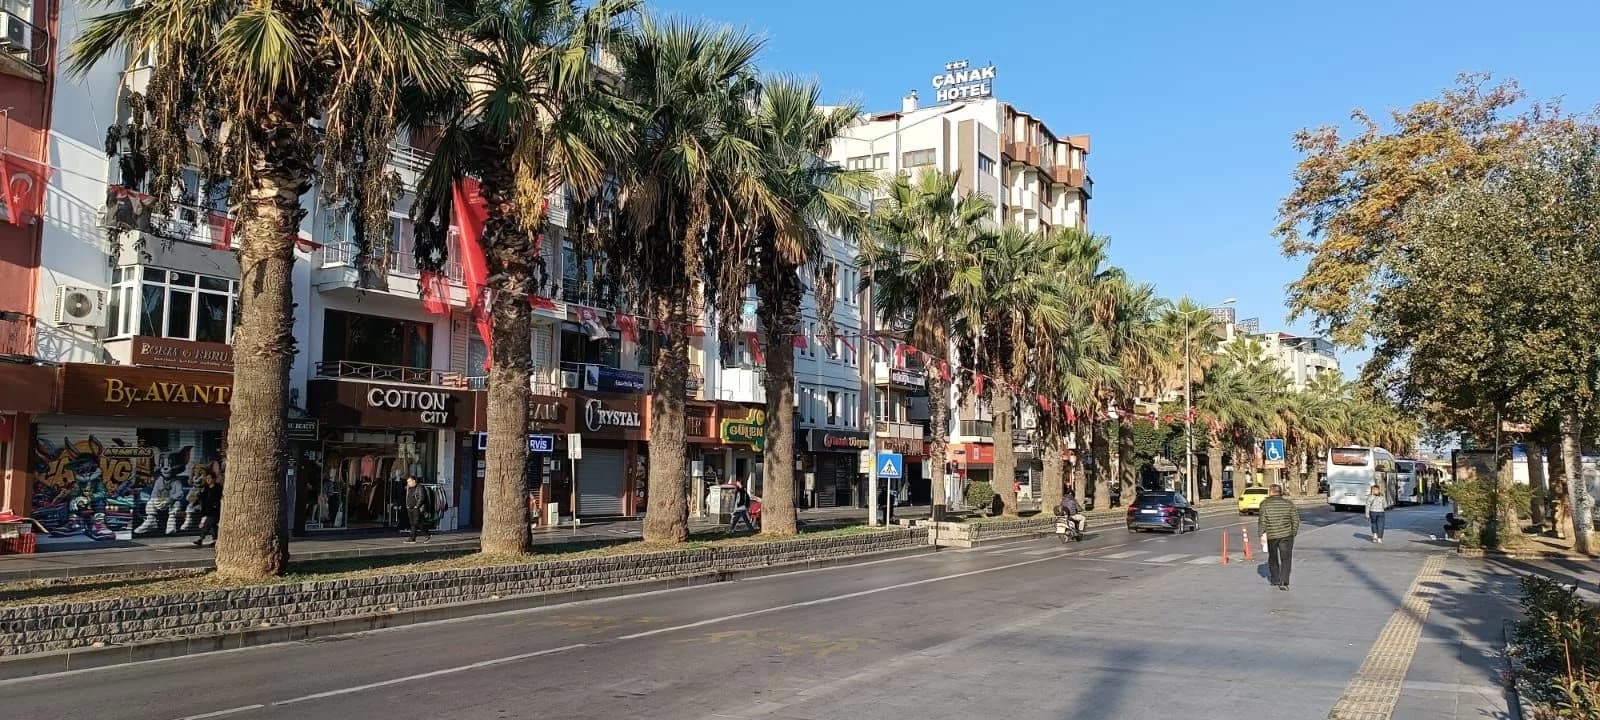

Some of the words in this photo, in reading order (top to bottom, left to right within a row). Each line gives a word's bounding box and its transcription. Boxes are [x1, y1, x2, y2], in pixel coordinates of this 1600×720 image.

[932, 66, 995, 89] ÇANAK
[937, 83, 990, 101] HOTEL
[368, 388, 446, 410] COTTON
[421, 411, 448, 424] CITY
[530, 438, 547, 449] RVİS
